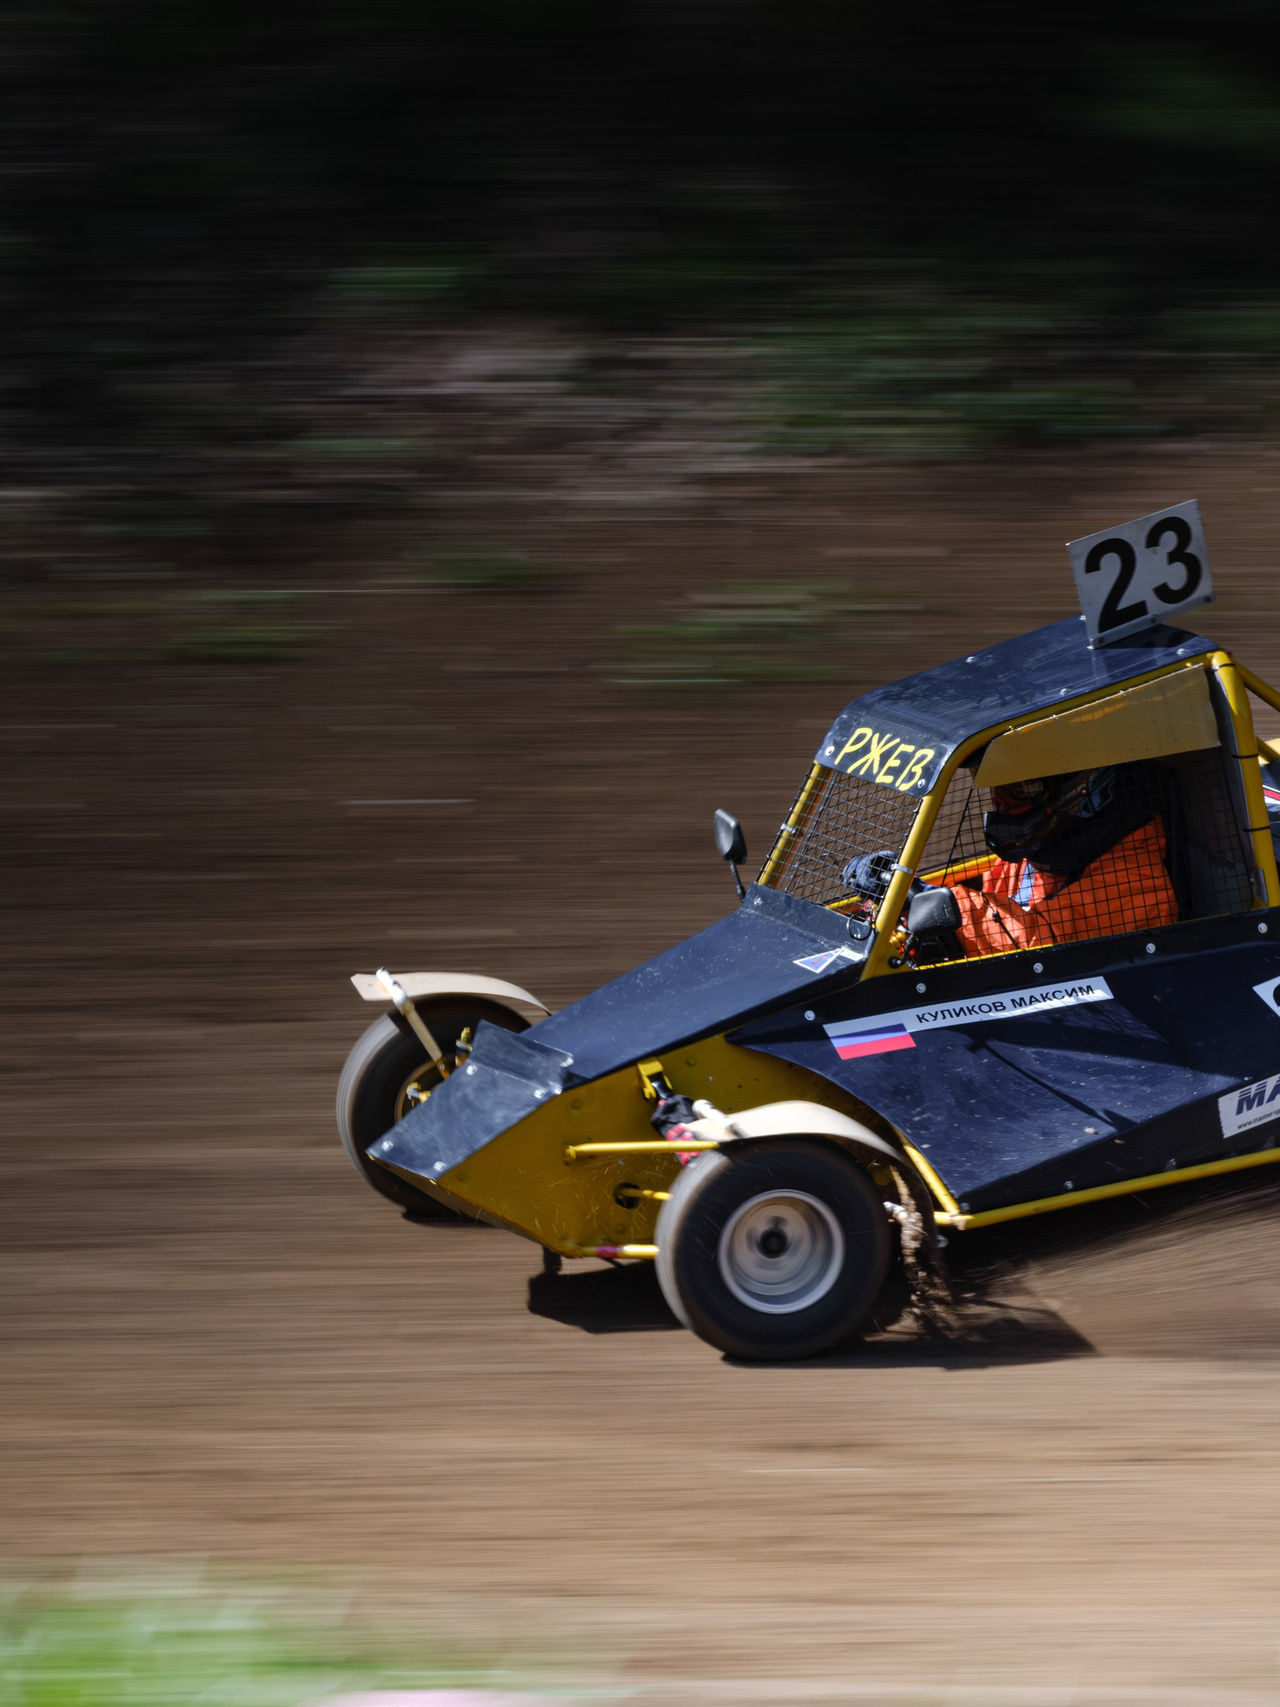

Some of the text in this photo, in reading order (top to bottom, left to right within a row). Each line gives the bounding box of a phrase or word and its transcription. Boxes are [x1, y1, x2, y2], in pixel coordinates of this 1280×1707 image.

[1084, 515, 1203, 635] 23
[833, 726, 935, 792] РЖЕВ
[915, 984, 1096, 1024] КУЛИКОВ МАКСИМ
